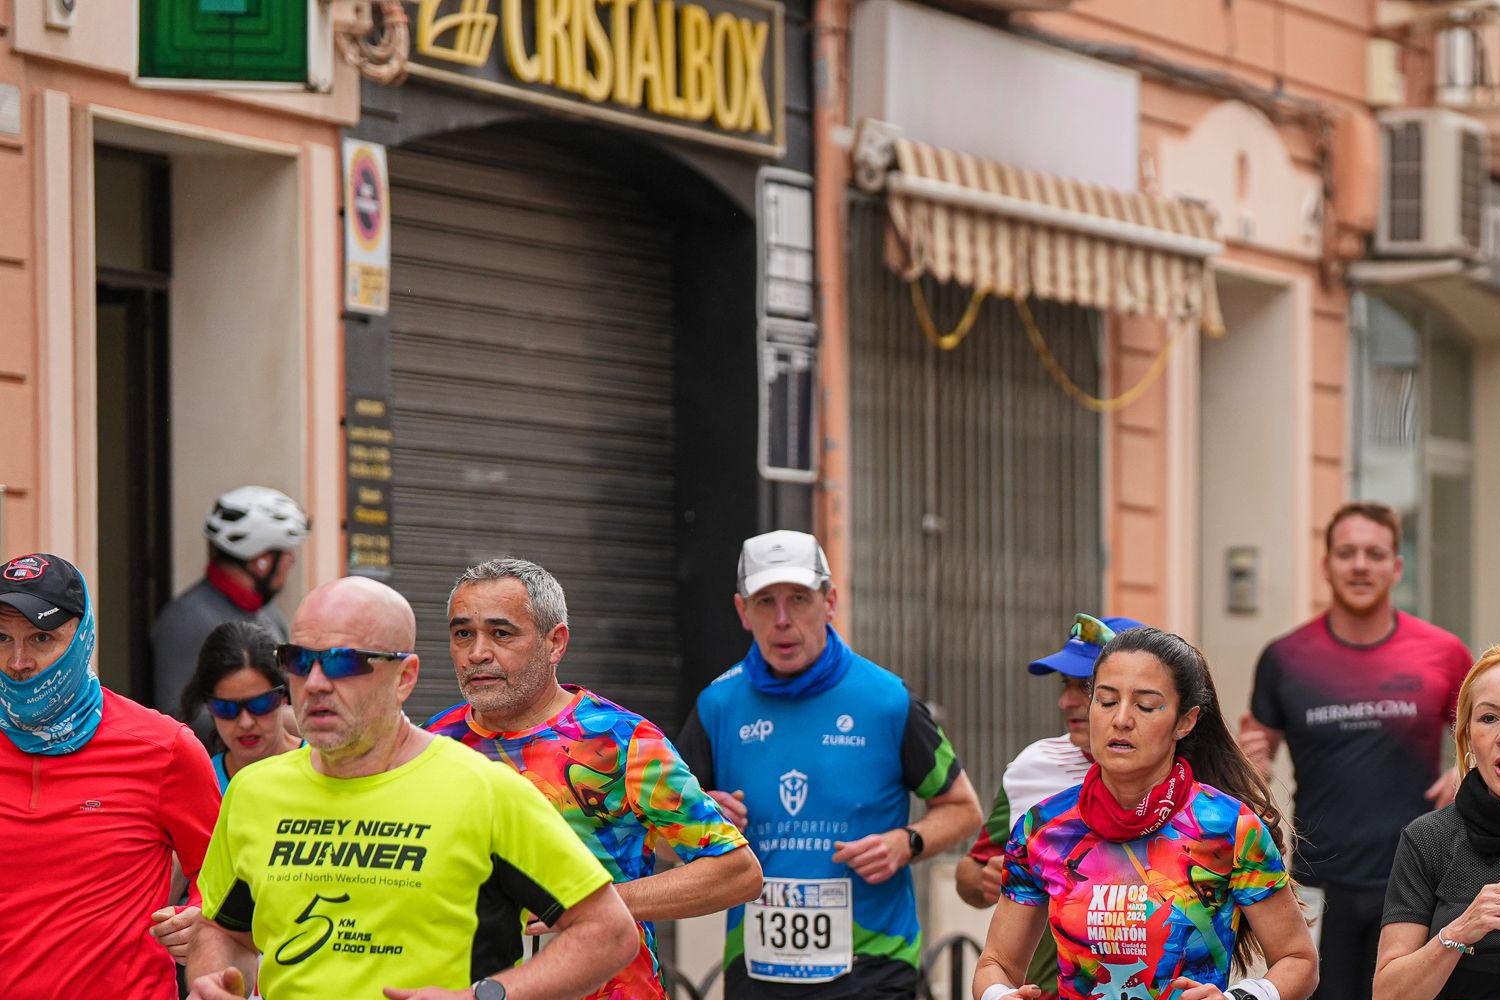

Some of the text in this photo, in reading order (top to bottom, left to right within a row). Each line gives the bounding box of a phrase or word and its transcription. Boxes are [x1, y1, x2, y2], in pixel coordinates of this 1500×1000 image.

[504, 0, 772, 134] CRISTALBOX
[27, 685, 57, 704] Mobility
[822, 734, 866, 747] ZURICH
[276, 819, 432, 839] GOREY NIGHT
[777, 821, 849, 834] DEPORTIVO
[268, 841, 428, 872] RUNNER
[277, 873, 291, 882] aid
[293, 872, 302, 882] of
[304, 873, 333, 882] North
[335, 873, 376, 885] Wexford
[379, 877, 422, 889] Hospice
[1088, 885, 1127, 911] XII
[1128, 885, 1148, 902] 08
[339, 919, 356, 928] KM
[1087, 911, 1126, 926] MEDIA
[1127, 911, 1147, 921] 2026
[275, 892, 351, 966] 5
[337, 931, 372, 942] YEARS
[755, 911, 831, 949] 1389
[1087, 924, 1147, 941] MARATÓN
[369, 945, 403, 955] EURO
[1091, 941, 1121, 955] & 10K
[1122, 948, 1147, 956] LUCENA
